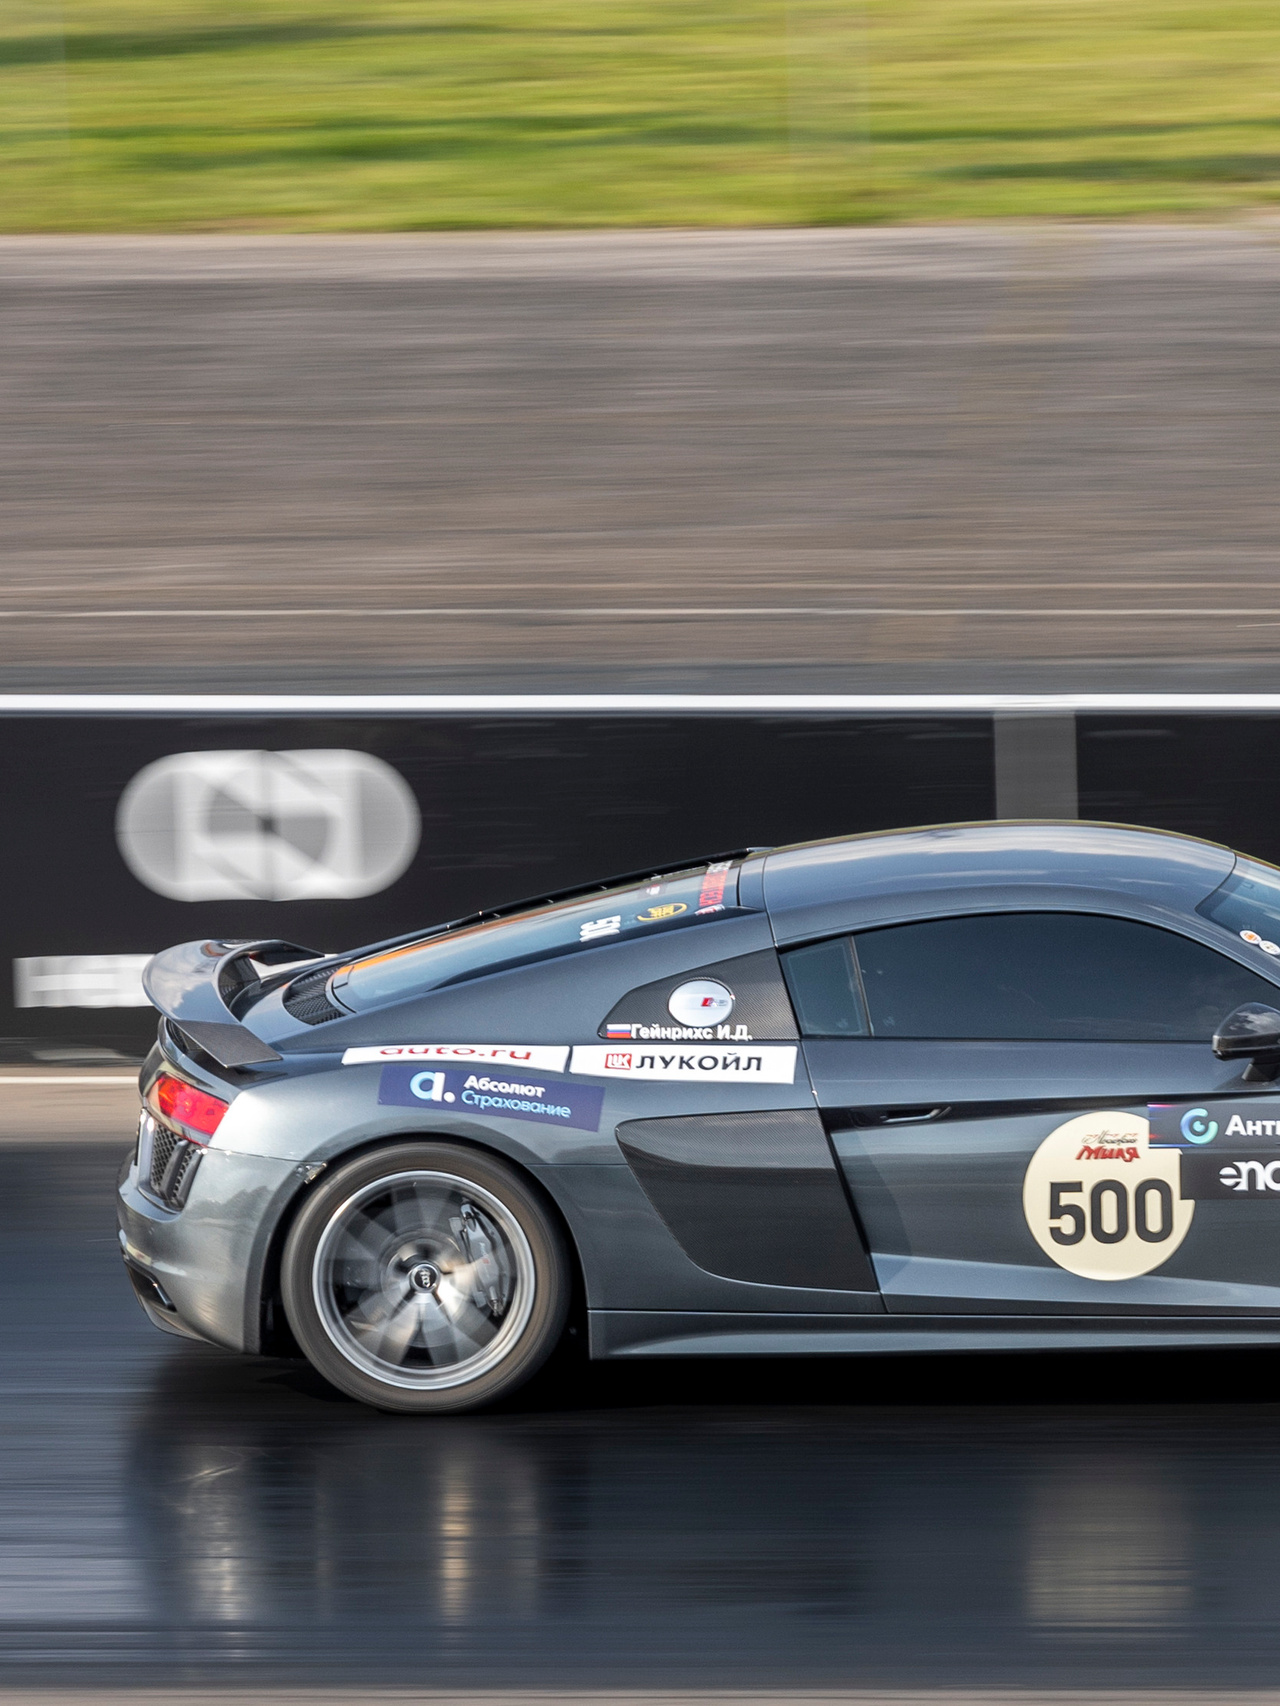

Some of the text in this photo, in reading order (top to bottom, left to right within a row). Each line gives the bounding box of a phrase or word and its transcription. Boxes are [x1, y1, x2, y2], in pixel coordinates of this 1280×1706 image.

[631, 1024, 713, 1041] Гейнрихс
[379, 1046, 531, 1060] auto.ru
[636, 1053, 762, 1071] ЛУКОЙЛ
[464, 1075, 546, 1098] Абсолют
[461, 1090, 571, 1118] Страхование
[1049, 1178, 1174, 1246] 500
